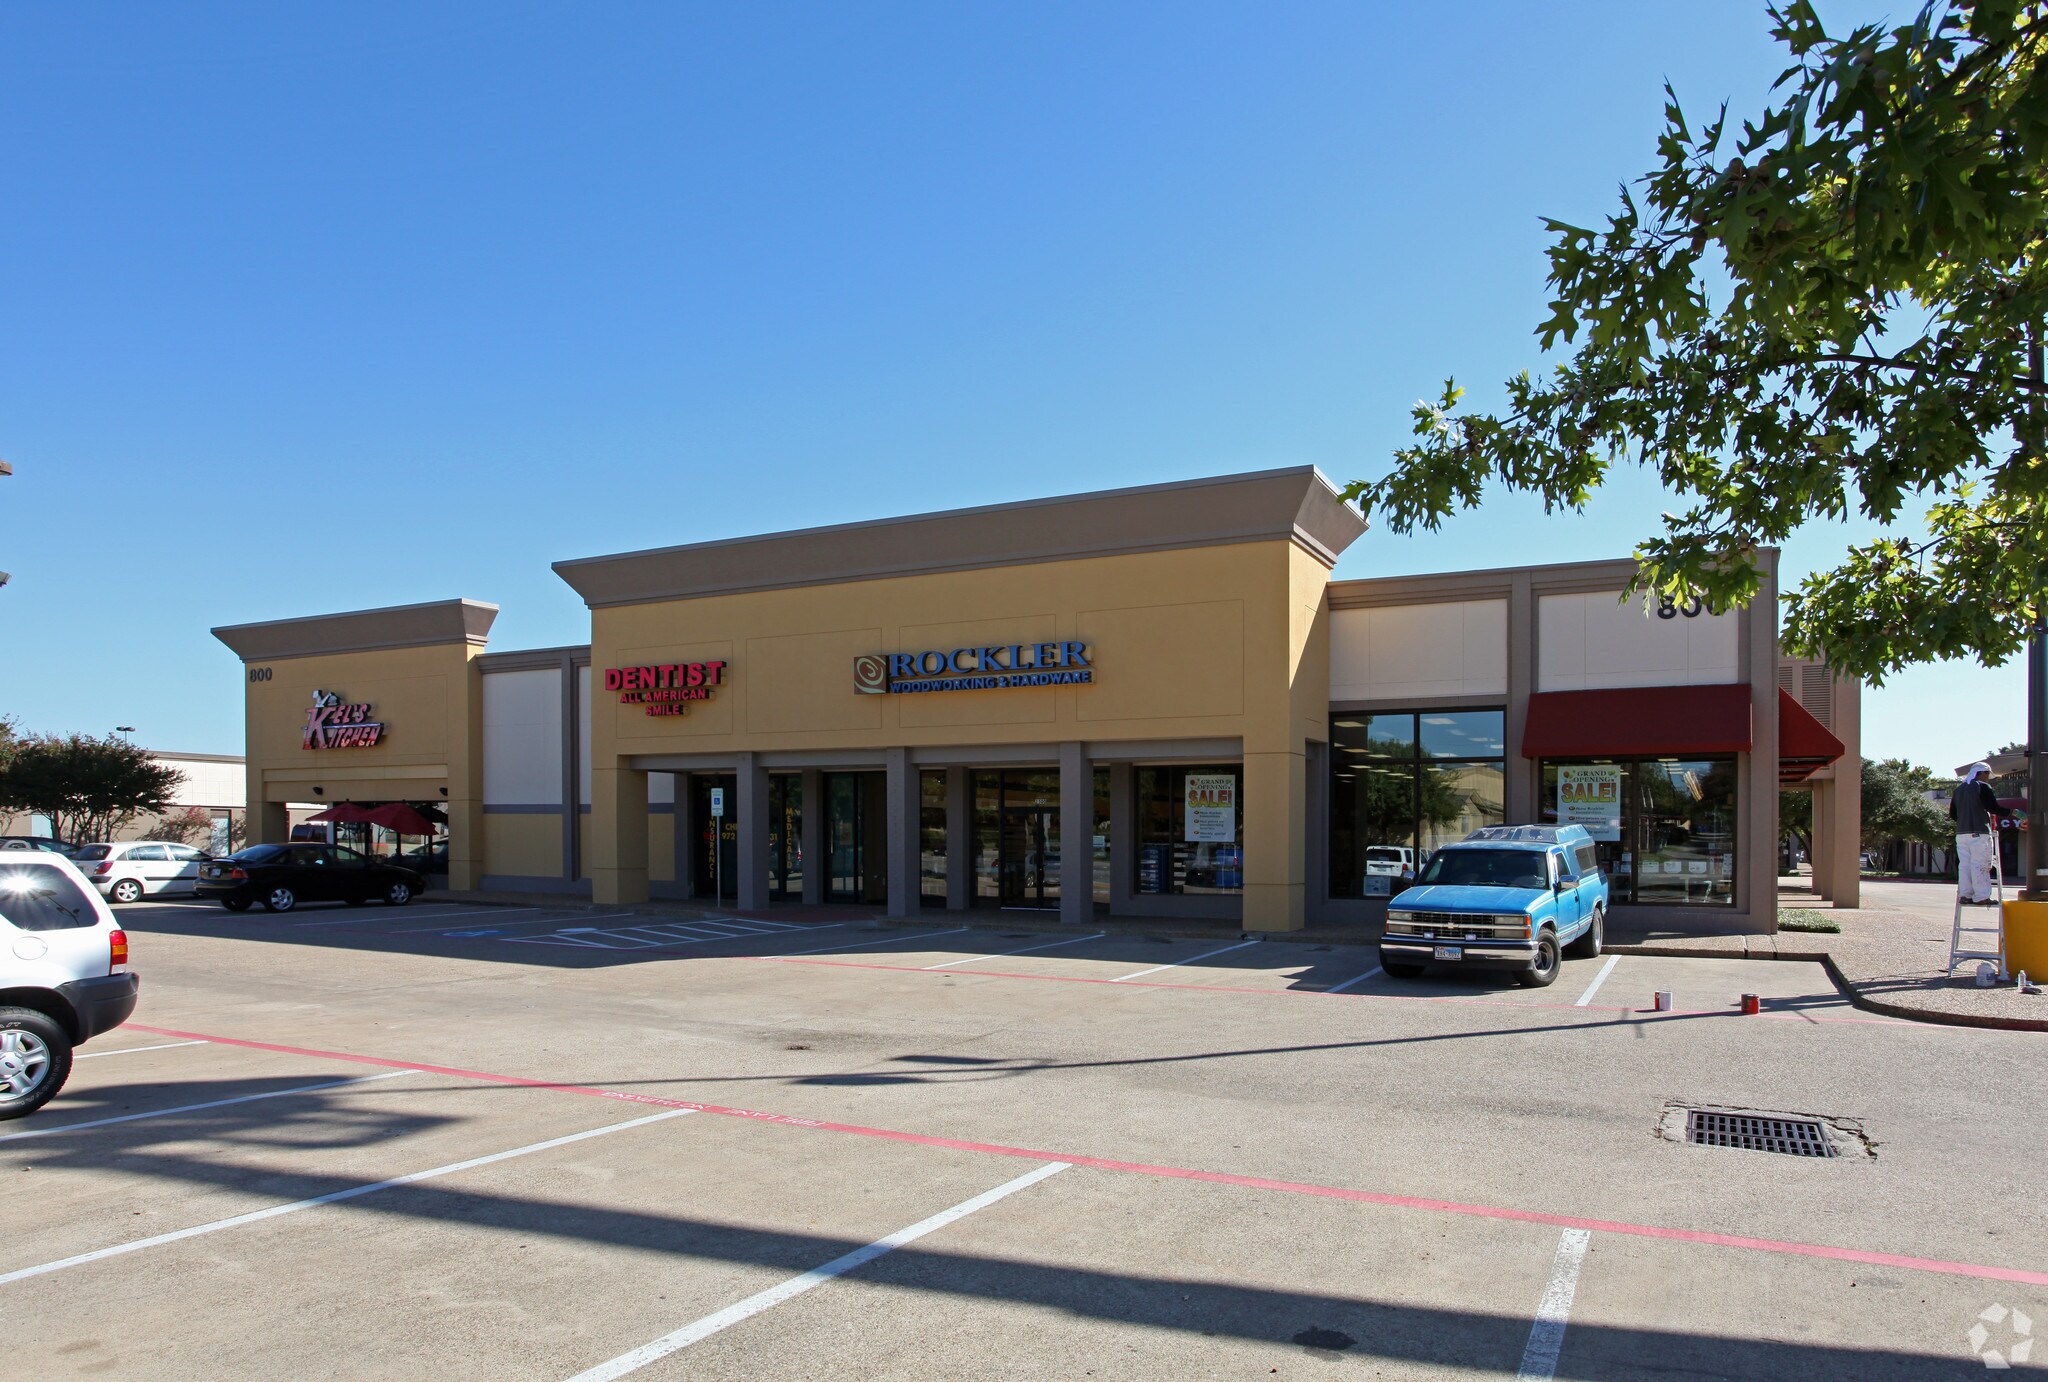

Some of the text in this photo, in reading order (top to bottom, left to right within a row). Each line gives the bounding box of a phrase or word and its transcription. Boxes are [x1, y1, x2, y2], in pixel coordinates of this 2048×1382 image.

[888, 641, 1090, 678] ROCKLER
[249, 667, 273, 683] 800
[605, 660, 725, 691] DENTIST
[889, 670, 1091, 694] WOODWORKING & HARDWARE
[620, 688, 708, 704] ALL AMERICAN
[645, 704, 682, 717] SMILE
[1188, 789, 1232, 808] SALE!
[1561, 782, 1617, 803] SALE!
